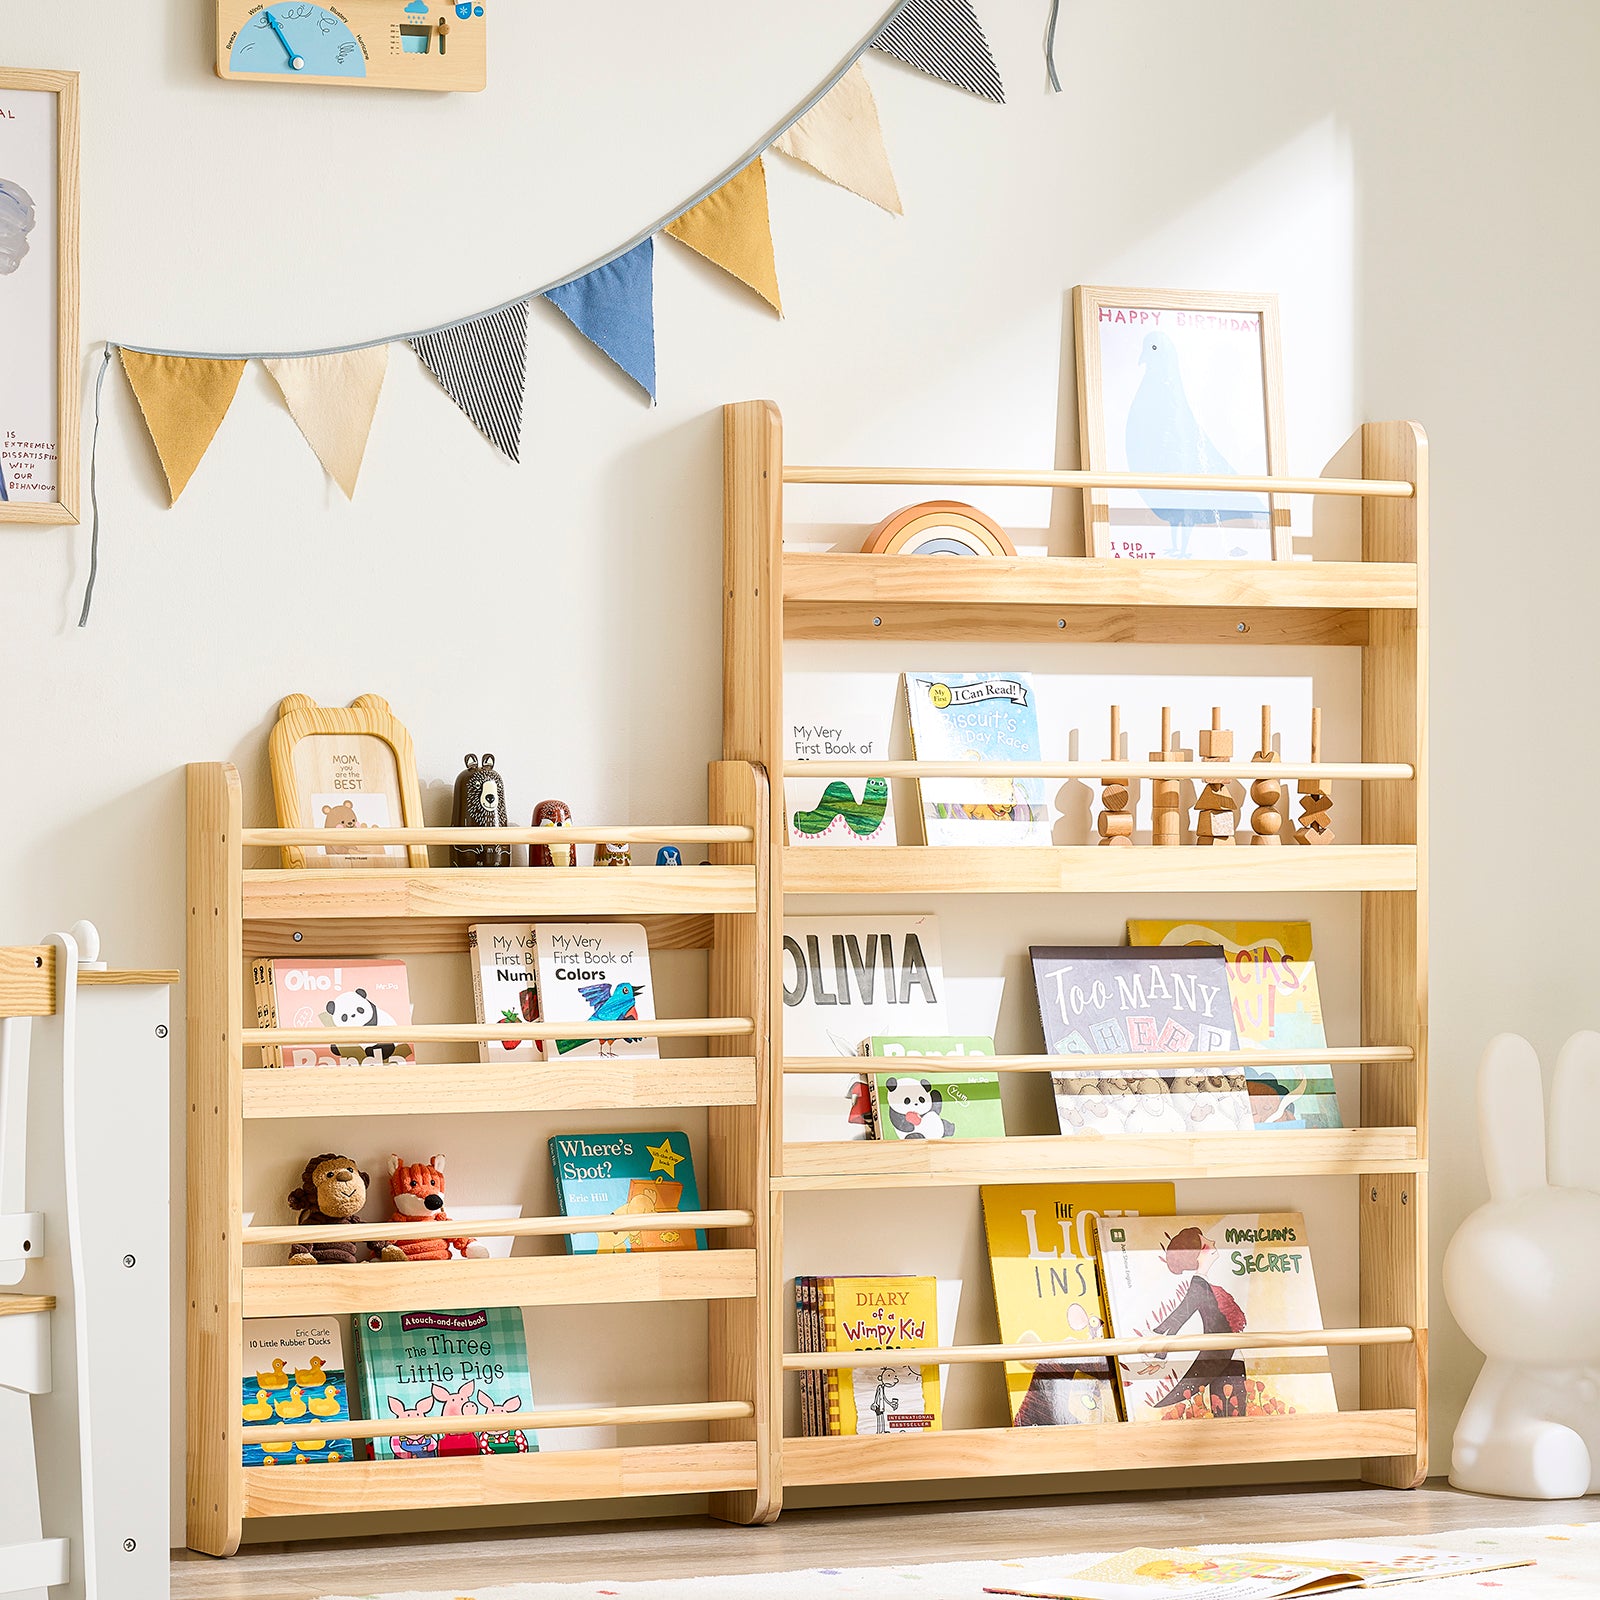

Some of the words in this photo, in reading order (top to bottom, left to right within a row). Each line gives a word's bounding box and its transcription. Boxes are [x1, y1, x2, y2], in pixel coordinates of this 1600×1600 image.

[248, 4, 264, 16] Windy
[329, 6, 349, 23] Blustery
[226, 31, 237, 50] Breeze
[356, 34, 369, 60] Hurricane
[1098, 307, 1161, 325] HAPPY
[1177, 311, 1260, 332] BIRTHDAY
[7, 431, 16, 439] IS
[9, 462, 35, 470] WITH
[14, 472, 33, 480] OUR
[9, 481, 56, 491] BEHAVIOUR
[1111, 541, 1116, 551] I
[1123, 541, 1142, 551] DID
[1128, 551, 1156, 559] SHIT
[954, 690, 959, 701] I
[961, 688, 984, 700] Can
[985, 684, 1017, 697] Read!
[793, 725, 812, 742] My
[813, 725, 843, 742] Very
[965, 729, 992, 744] Day
[996, 732, 1030, 752] Race
[795, 741, 821, 755] First
[825, 741, 857, 755] Book
[860, 741, 874, 755] of
[334, 779, 362, 790] BEST
[493, 935, 512, 952] My
[552, 934, 571, 951] My
[572, 934, 602, 951] Very
[495, 952, 521, 966] First
[553, 954, 580, 968] First
[584, 953, 617, 966] Book
[620, 951, 634, 965] of
[497, 969, 537, 982] Num
[554, 968, 606, 983] Colors
[783, 933, 938, 1007] OLIVIA
[285, 968, 342, 991] Oho!
[1044, 965, 1114, 1026] Too
[1114, 964, 1221, 1018] MANY
[1066, 1020, 1223, 1056] SHEEP
[558, 1139, 633, 1158] Where's
[562, 1161, 613, 1184] Spot?
[569, 1193, 589, 1204] Eric
[590, 1192, 609, 1203] Hill
[1053, 1200, 1074, 1219] THE
[1020, 1209, 1139, 1261] LIO
[1225, 1226, 1297, 1245] MAGICIAN'S
[1230, 1250, 1303, 1276] SECRET
[1035, 1263, 1087, 1298] INS
[855, 1291, 909, 1307] DIARY
[405, 1317, 411, 1326] A
[411, 1316, 467, 1327] touch-and-feel
[468, 1315, 486, 1327] book
[872, 1308, 884, 1320] of
[887, 1312, 895, 1320] a
[295, 1329, 309, 1337] Eric
[310, 1328, 330, 1337] Carle
[842, 1321, 895, 1345] Wimpy
[900, 1318, 925, 1340] Kid
[249, 1340, 258, 1348] 10
[259, 1339, 279, 1347] Little
[280, 1338, 306, 1347] Rubber
[307, 1337, 331, 1346] Ducks
[404, 1346, 427, 1359] The
[427, 1333, 491, 1356] Three
[395, 1362, 454, 1384] Little
[459, 1361, 505, 1385] Pigs
